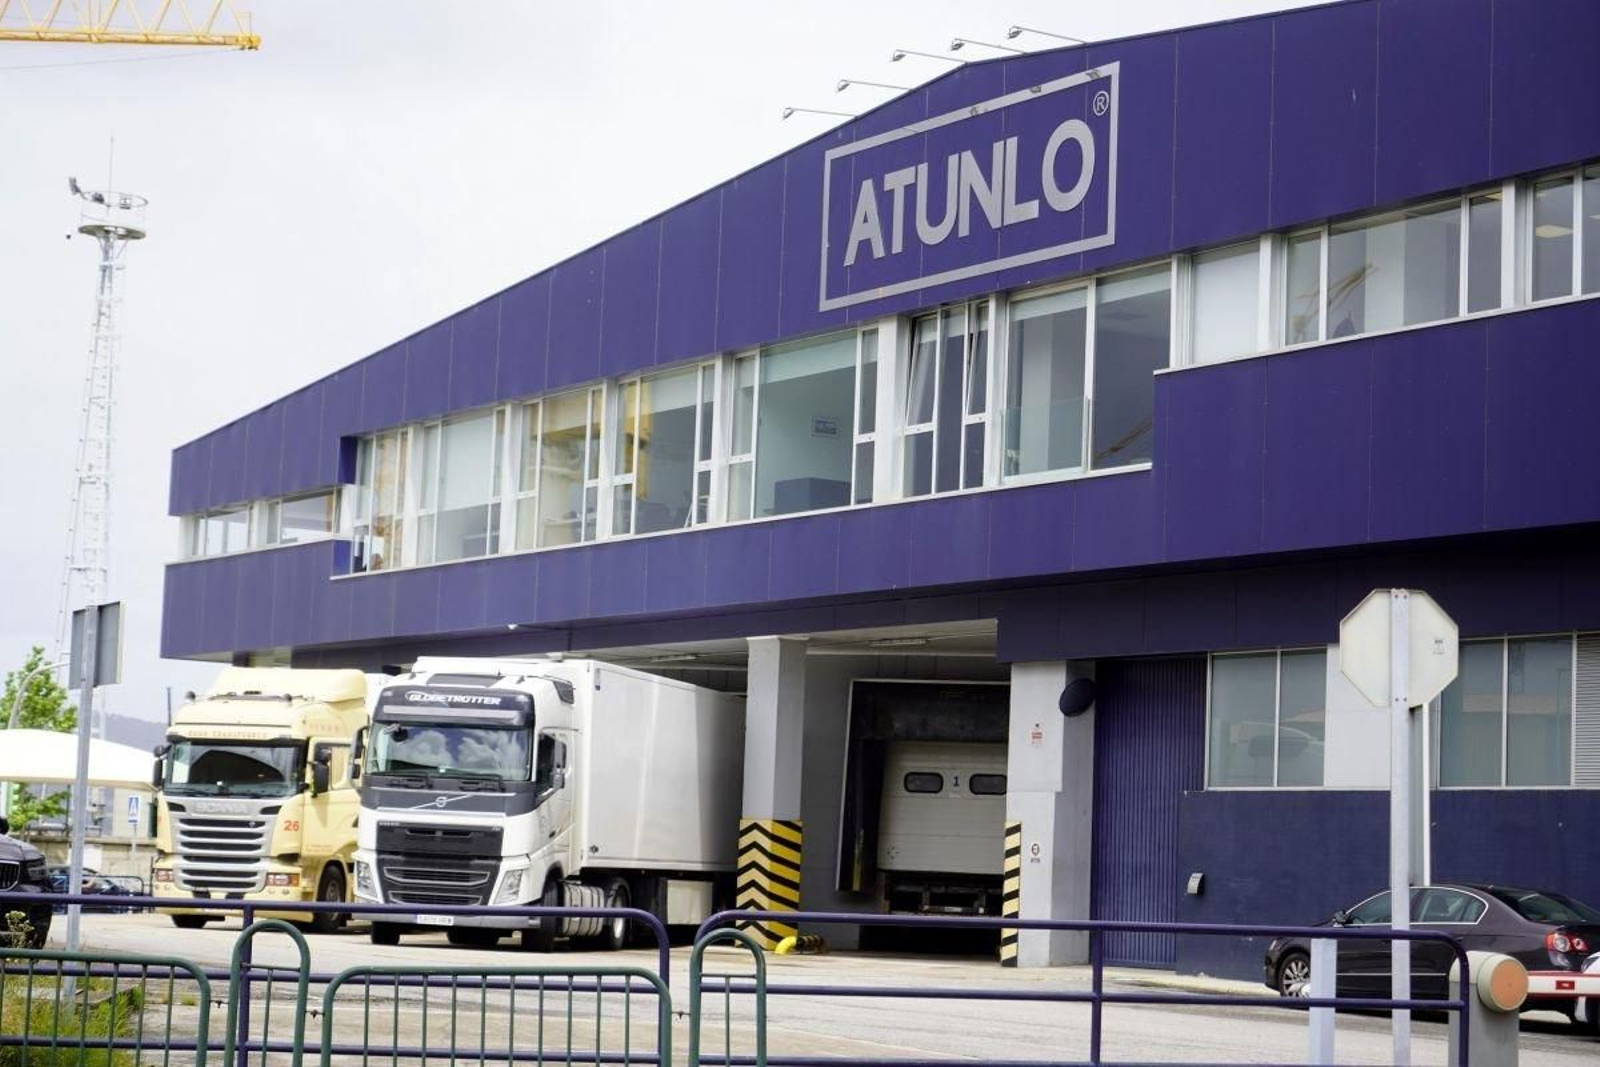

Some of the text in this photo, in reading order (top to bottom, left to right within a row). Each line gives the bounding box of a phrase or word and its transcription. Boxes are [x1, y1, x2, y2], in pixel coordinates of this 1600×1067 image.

[843, 118, 1096, 267] ATUNLO
[953, 776, 960, 787] 1
[283, 820, 300, 832] 26
